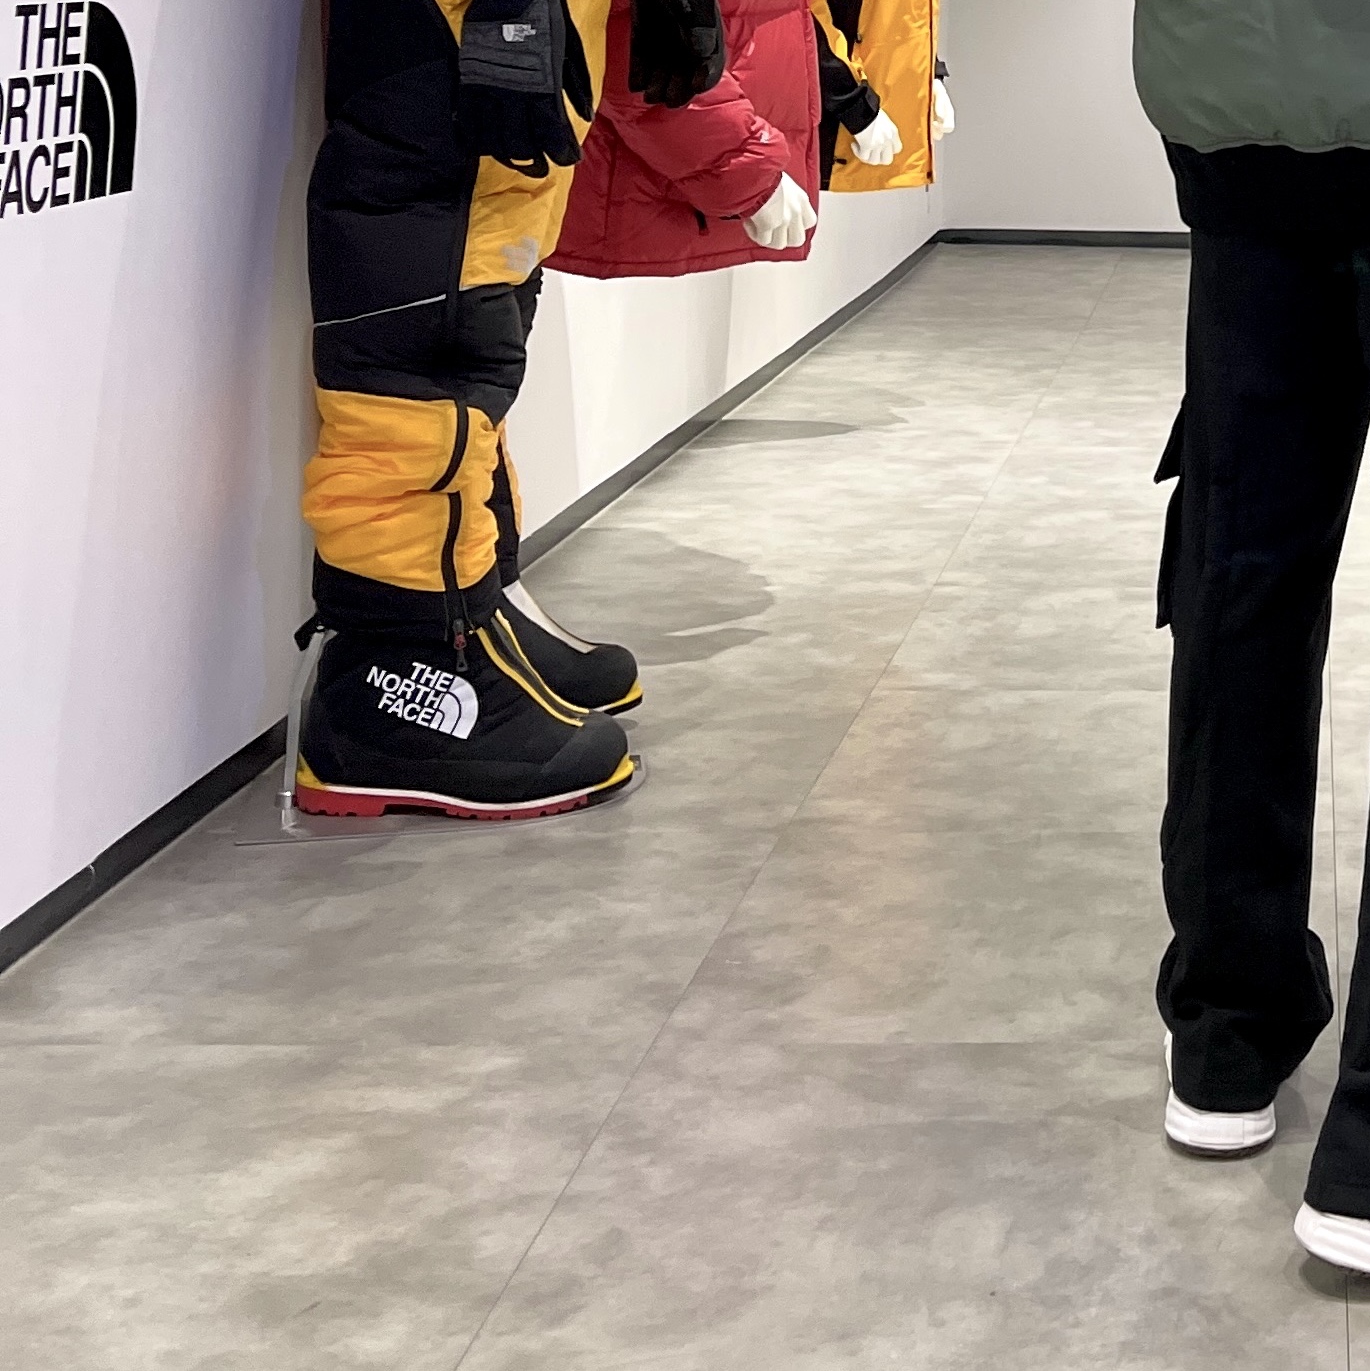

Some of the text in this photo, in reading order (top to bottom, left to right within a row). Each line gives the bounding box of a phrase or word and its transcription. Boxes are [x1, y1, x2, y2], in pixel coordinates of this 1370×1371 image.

[15, 1, 85, 70] THE
[0, 70, 80, 145] RTH
[366, 666, 448, 707] NORTH
[410, 661, 452, 689] THE
[378, 694, 437, 729] FACE
